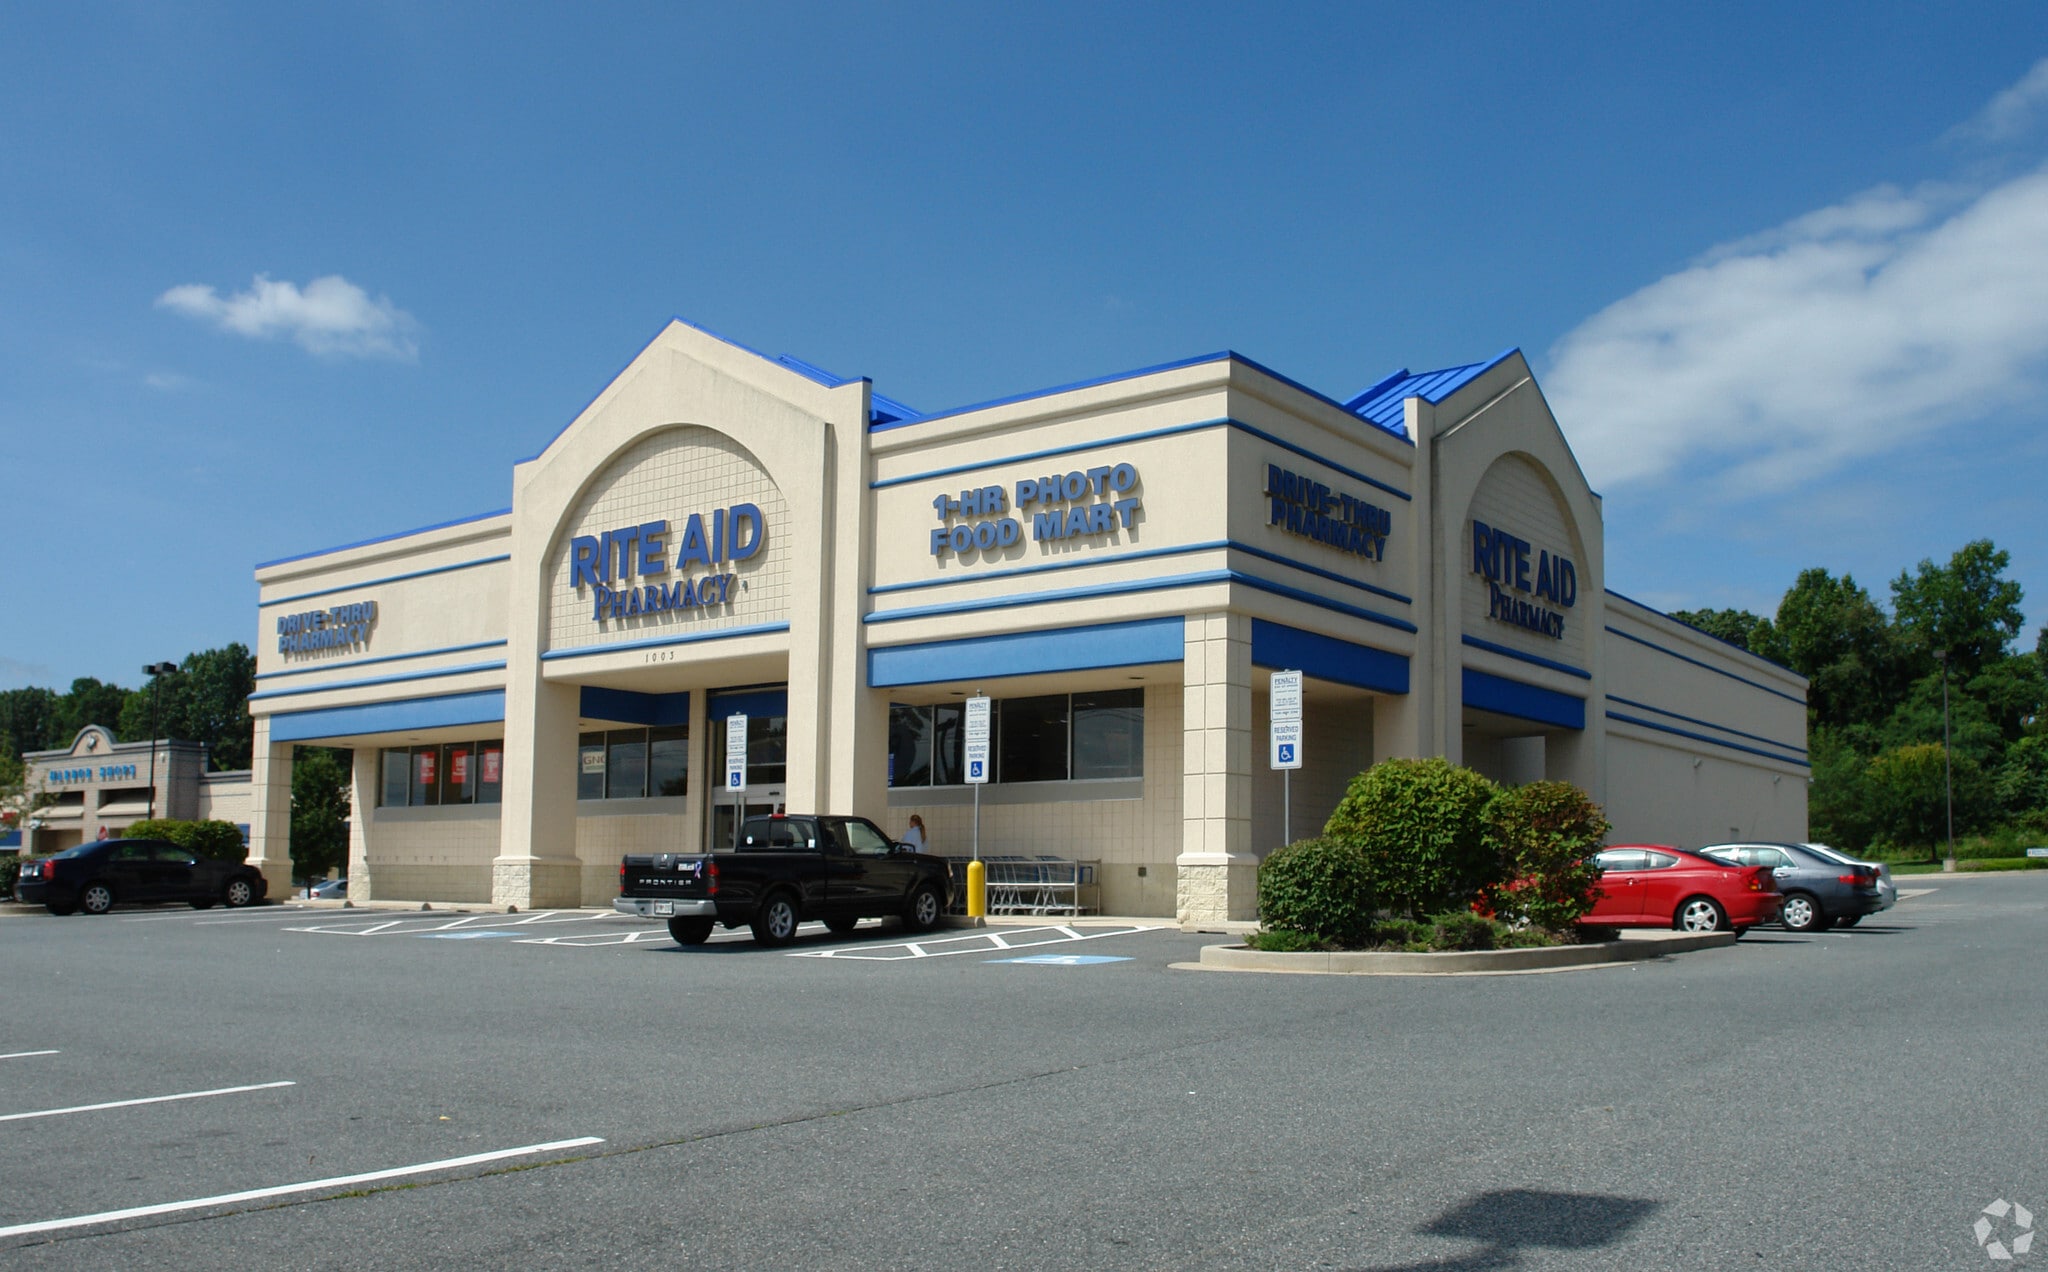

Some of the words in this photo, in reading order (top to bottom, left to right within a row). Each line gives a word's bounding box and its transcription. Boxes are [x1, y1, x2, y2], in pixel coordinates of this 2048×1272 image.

[932, 485, 1005, 521] 1-HR
[1016, 462, 1138, 508] PHOTO
[1266, 463, 1391, 537] DRIVE-THRU
[570, 519, 668, 588] RITE
[676, 502, 764, 570] AID
[930, 518, 1020, 555] FOOD
[1033, 498, 1140, 541] MART
[1269, 497, 1387, 562] PHARMACY
[1472, 519, 1531, 593] RITE
[1536, 549, 1577, 608] AID
[277, 600, 375, 635] DRIVE-THRU
[592, 573, 736, 621] PHARMACY
[1489, 581, 1565, 640] PHARMACY
[278, 623, 368, 654] PHARMACY
[645, 651, 674, 663] 1003
[1274, 725, 1299, 733] RESERVED
